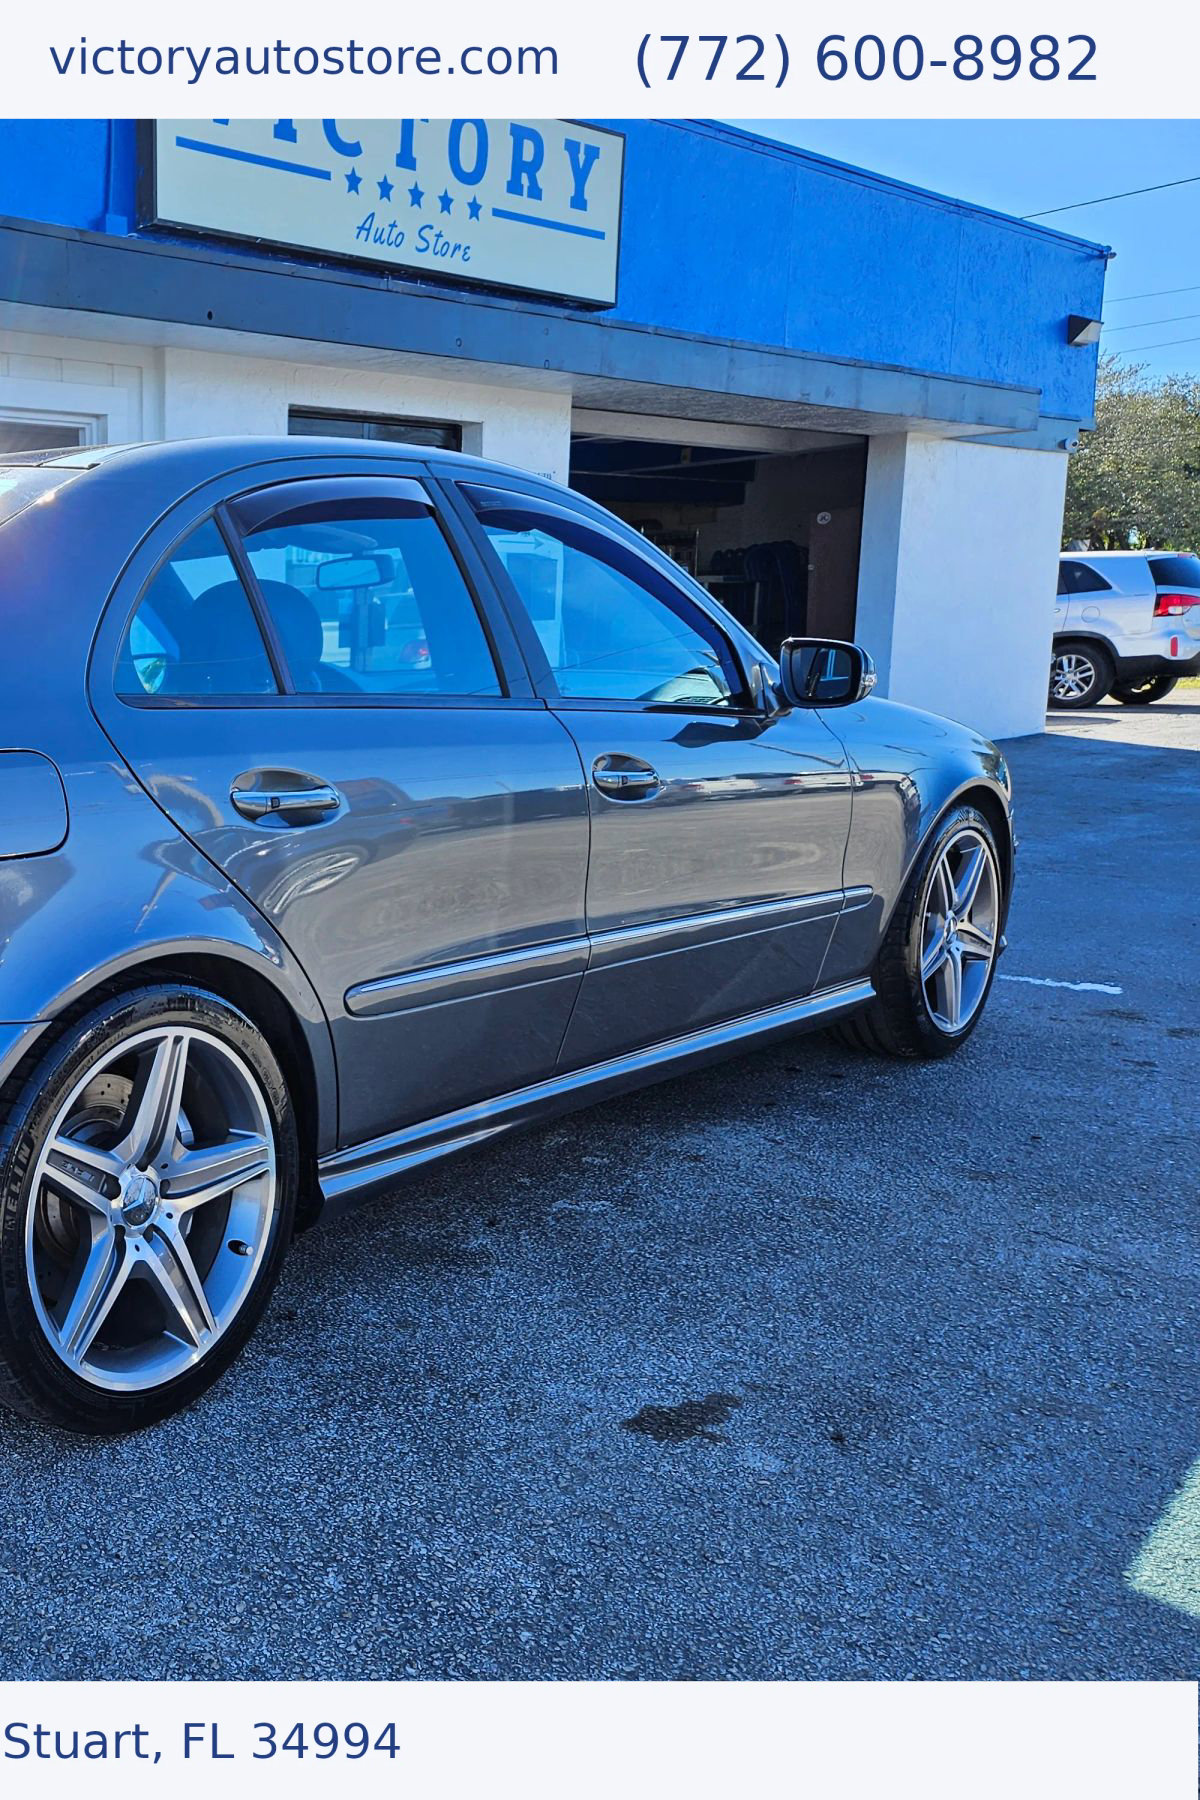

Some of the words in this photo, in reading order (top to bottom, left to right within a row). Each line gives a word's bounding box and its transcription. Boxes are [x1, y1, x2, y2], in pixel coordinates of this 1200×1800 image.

[212, 119, 600, 212] TORY
[356, 211, 405, 248] Auto
[415, 224, 471, 262] Store
